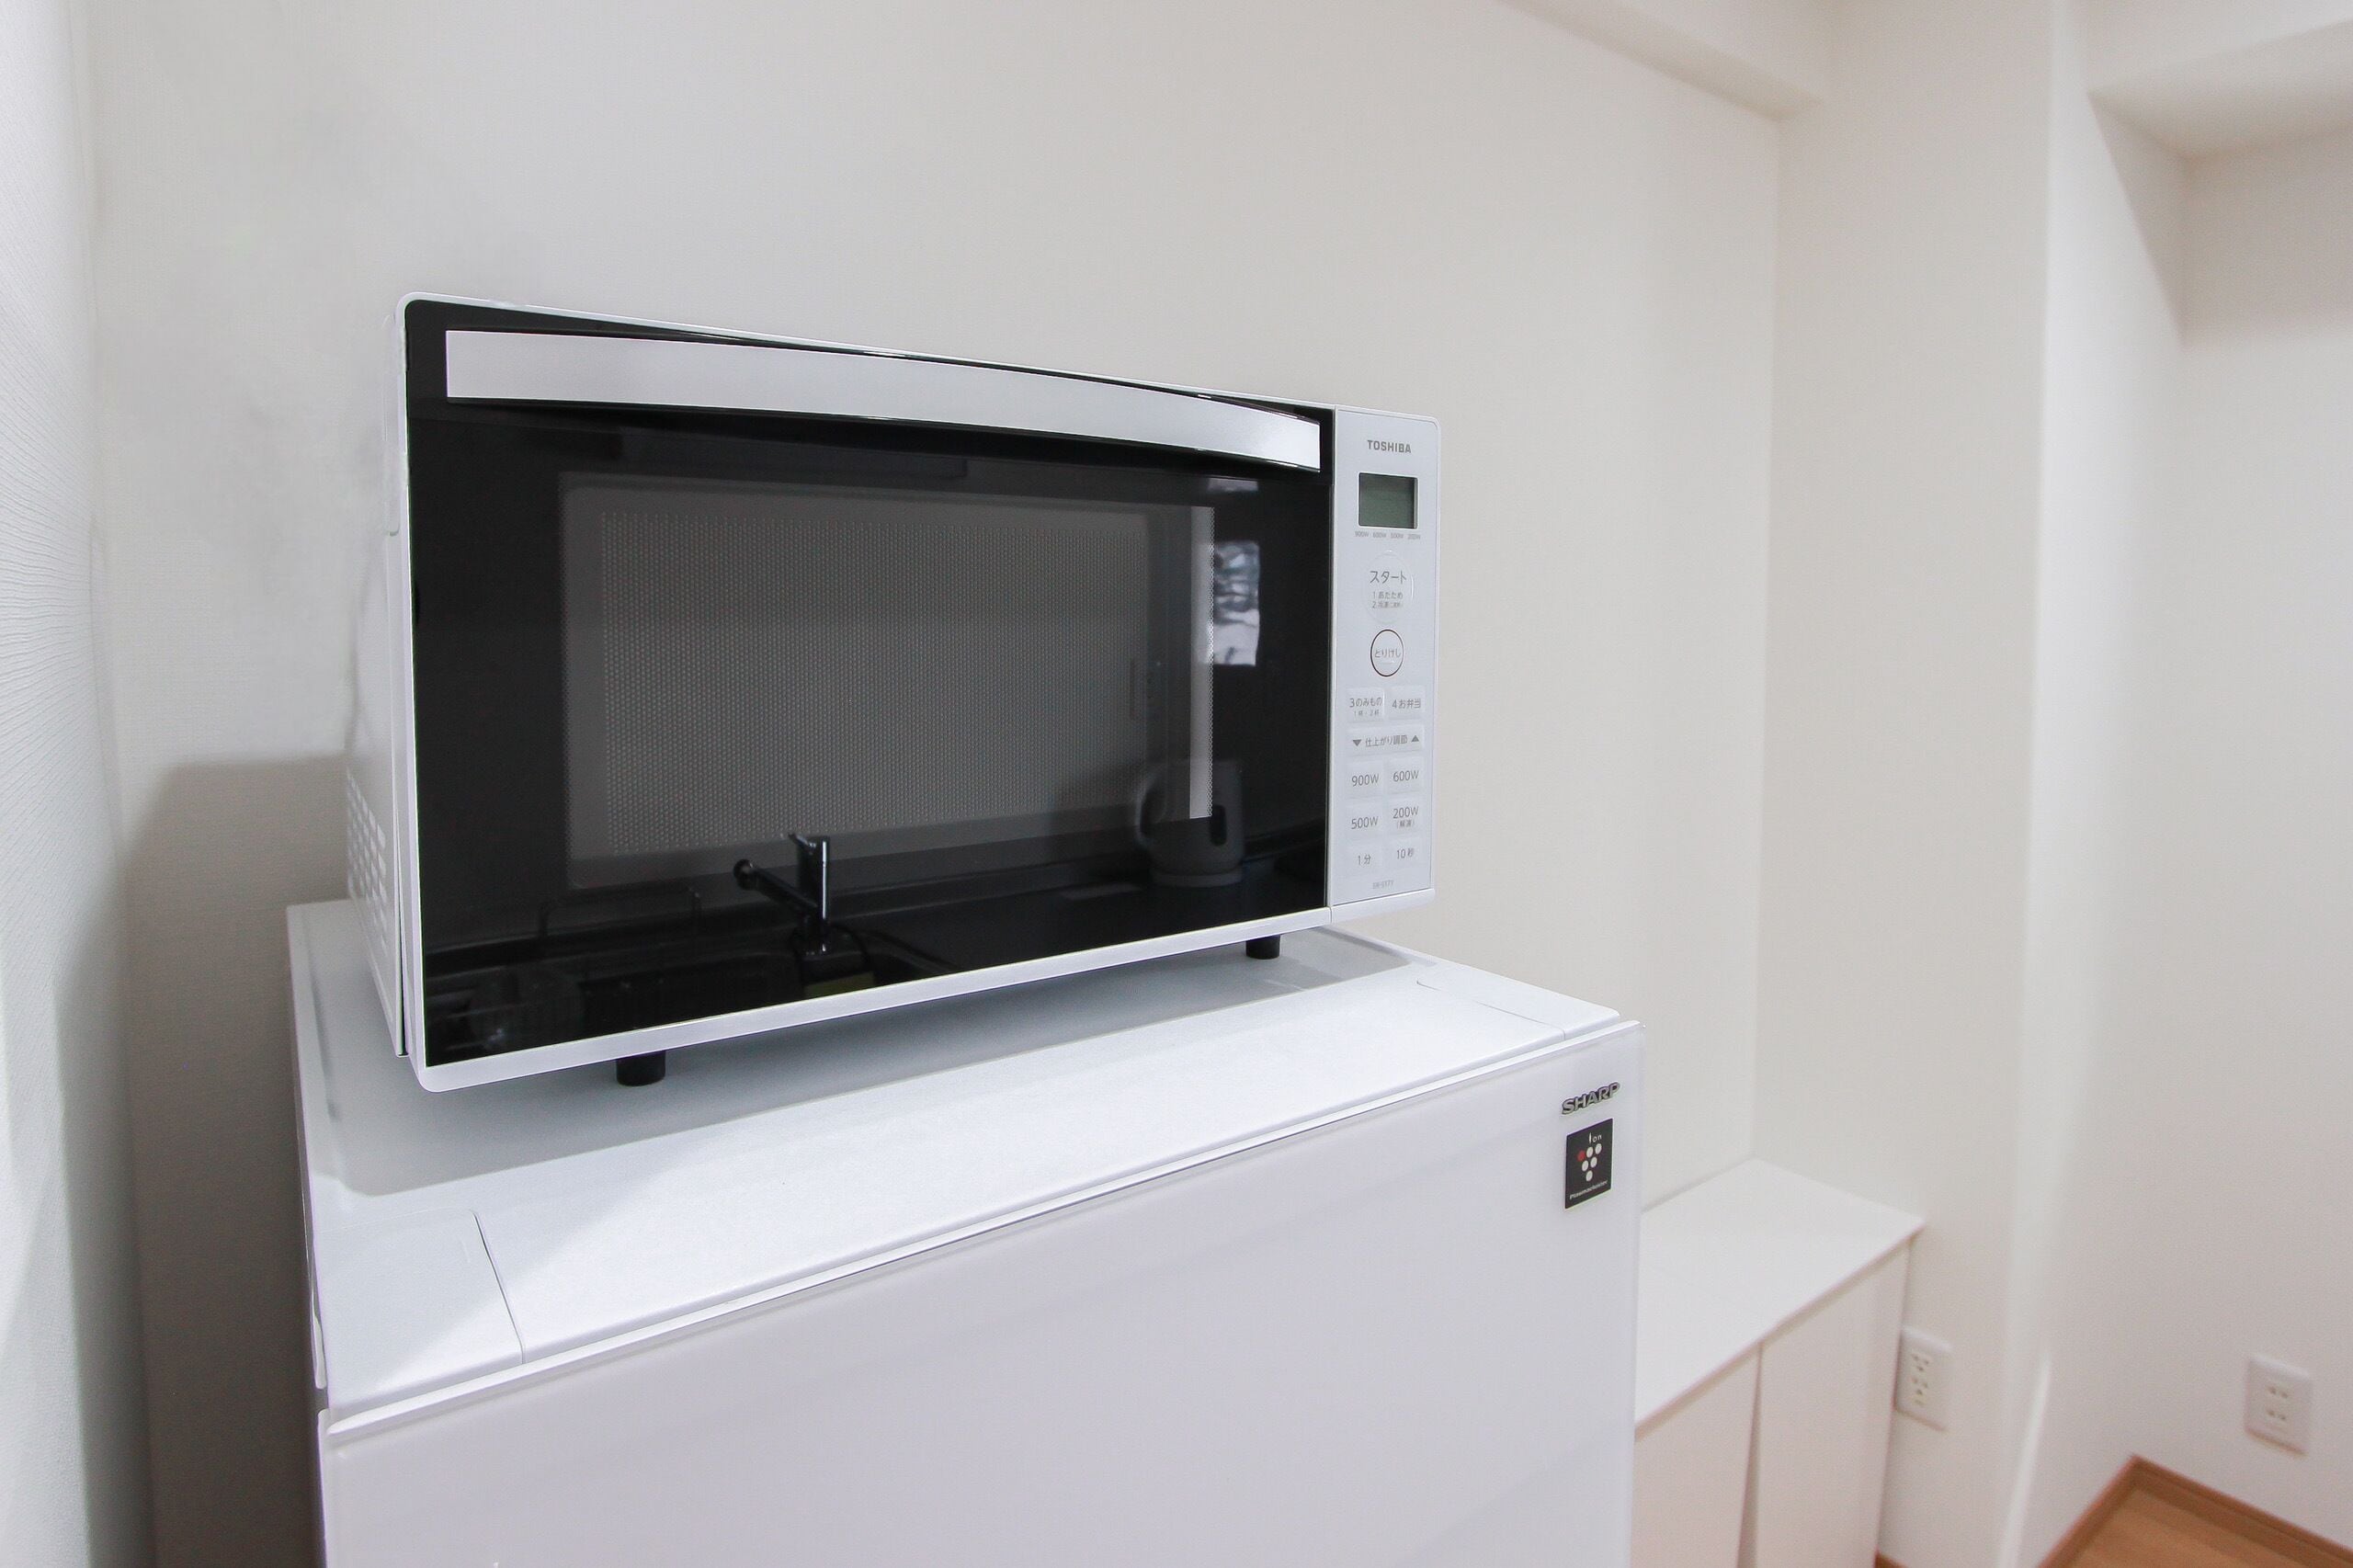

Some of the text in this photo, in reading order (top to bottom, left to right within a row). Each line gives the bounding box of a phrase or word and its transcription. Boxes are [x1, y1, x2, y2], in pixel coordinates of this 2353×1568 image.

[1367, 439, 1412, 454] TOSHIBA
[1370, 570, 1406, 585] スタート
[1374, 648, 1402, 658] とりけし
[1351, 774, 1380, 787] 900W
[1392, 770, 1419, 782] 600W
[1392, 806, 1419, 819] 200W
[1351, 816, 1379, 830] 500W
[1562, 1082, 1620, 1115] SHARP
